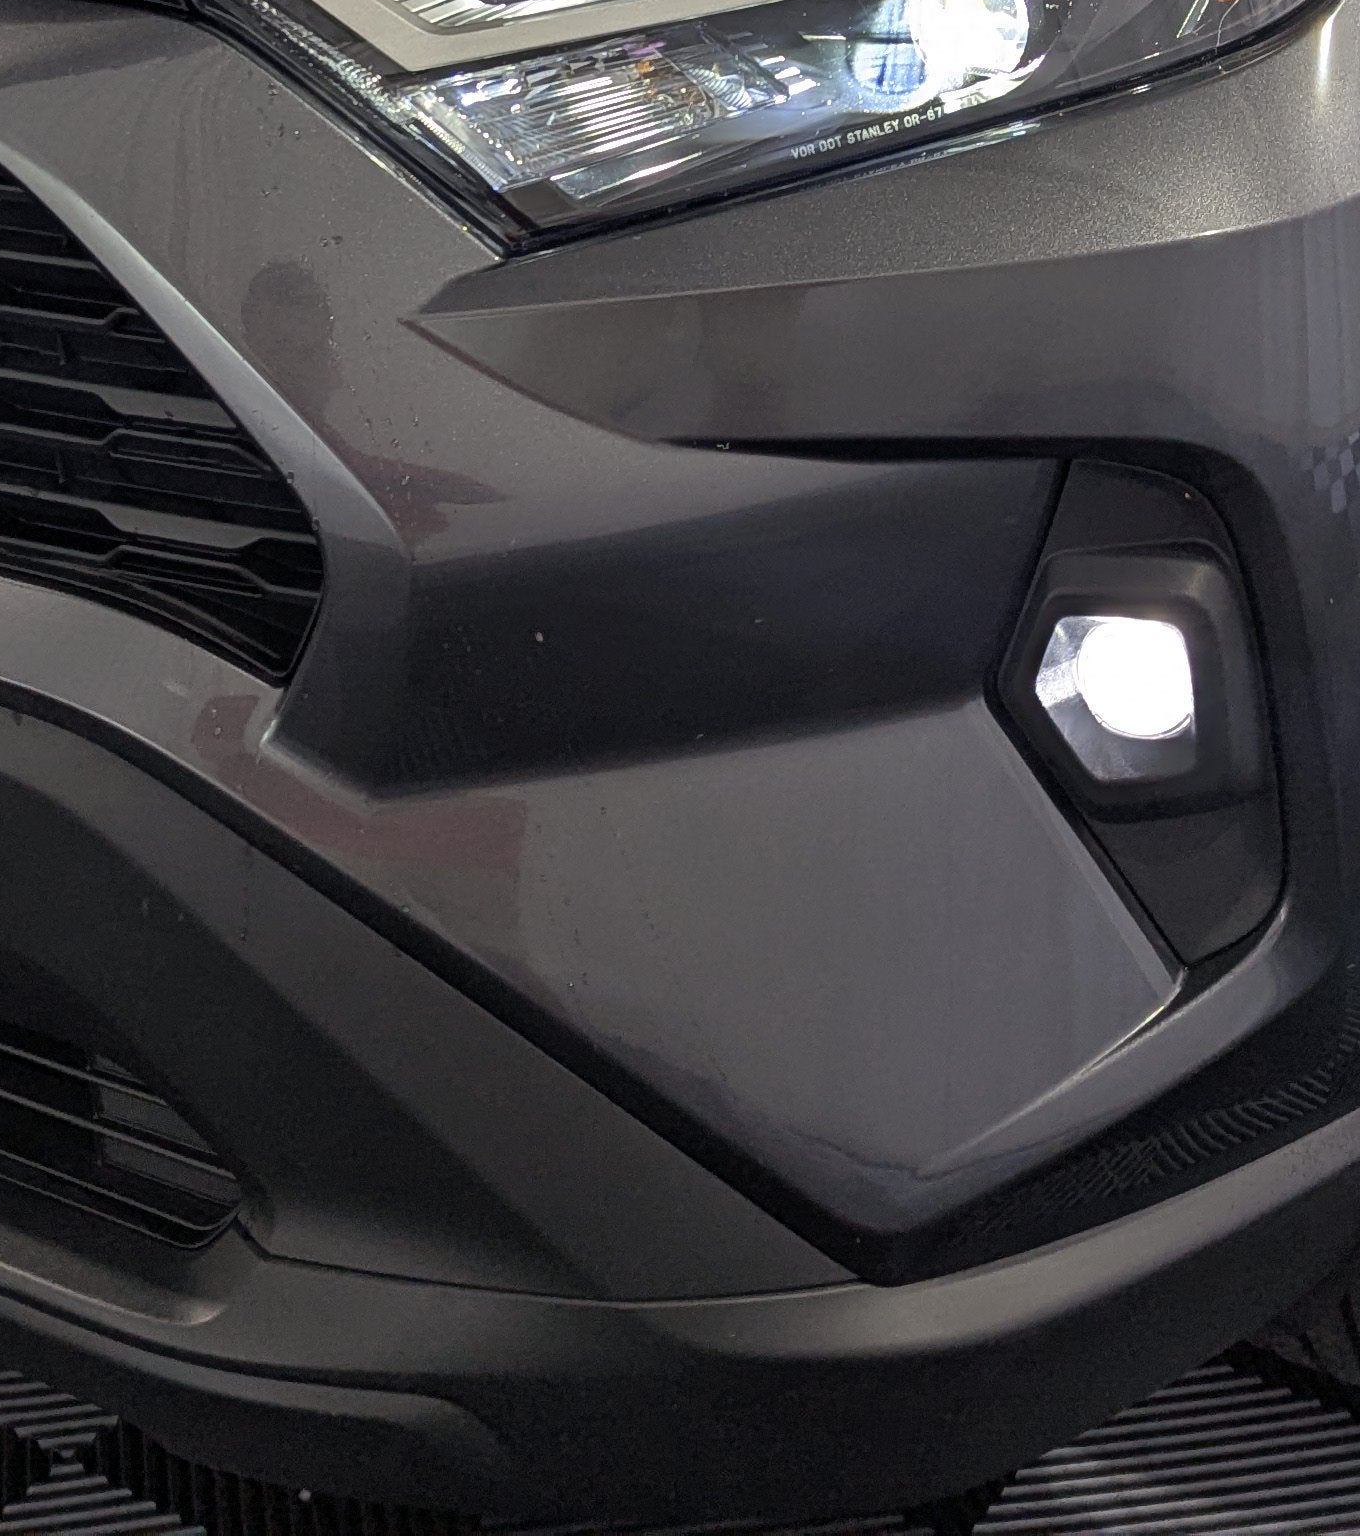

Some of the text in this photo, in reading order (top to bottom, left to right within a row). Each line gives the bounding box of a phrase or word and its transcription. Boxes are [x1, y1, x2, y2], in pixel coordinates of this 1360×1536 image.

[791, 143, 816, 160] VOR
[819, 135, 842, 153] DOT
[846, 118, 900, 145] STANLEY
